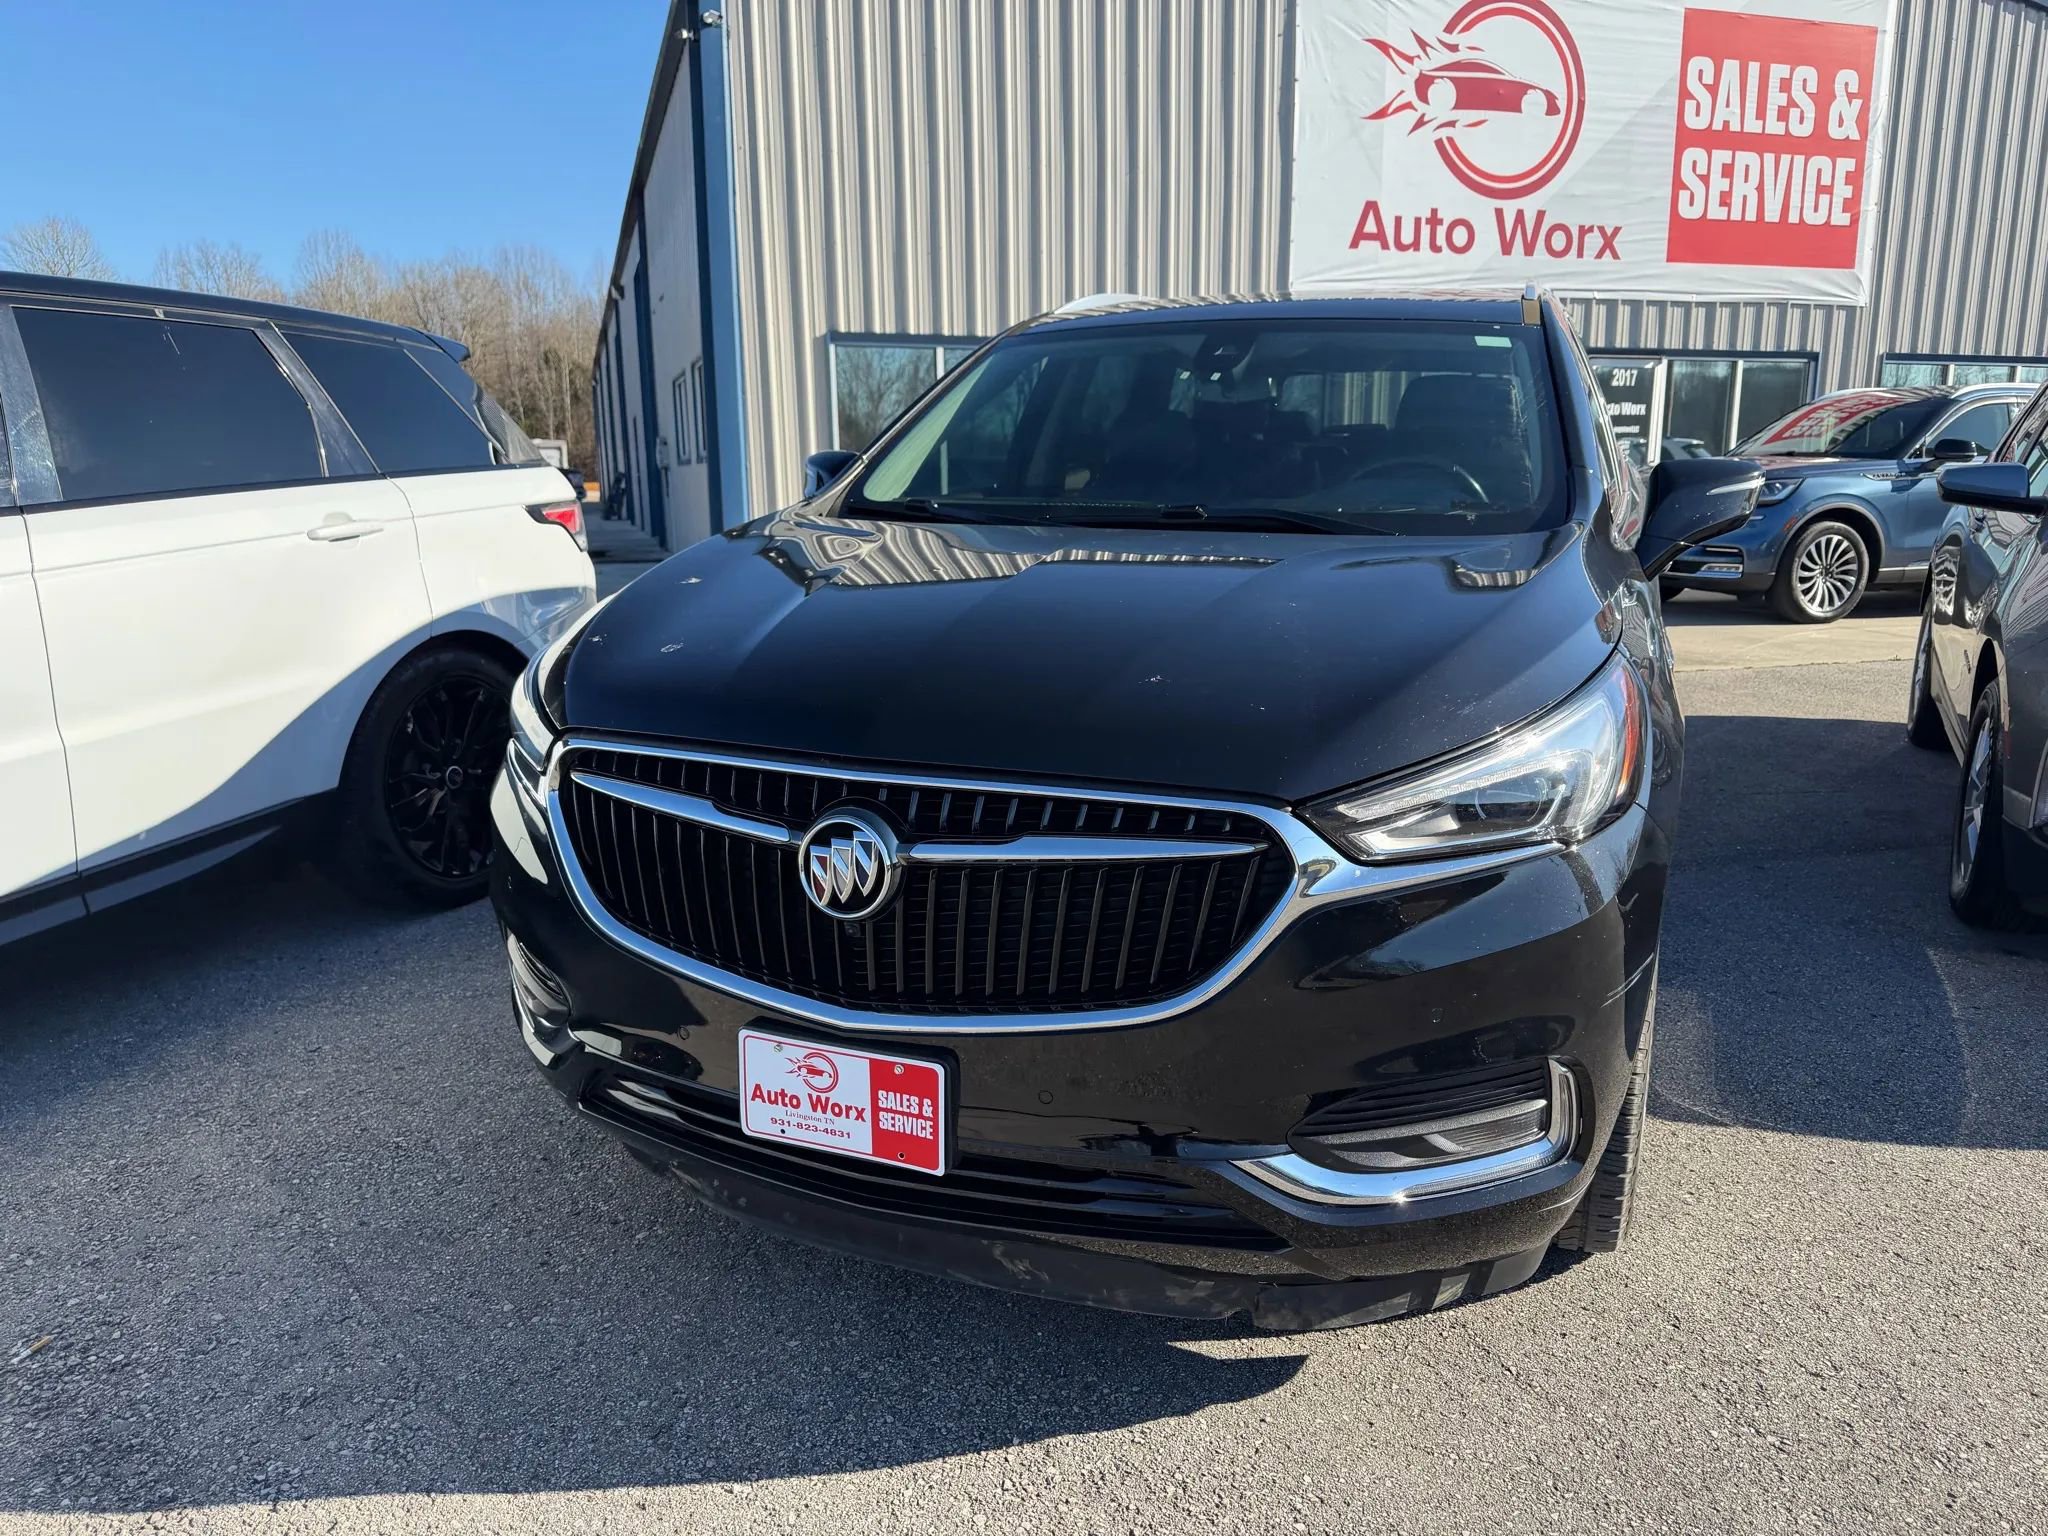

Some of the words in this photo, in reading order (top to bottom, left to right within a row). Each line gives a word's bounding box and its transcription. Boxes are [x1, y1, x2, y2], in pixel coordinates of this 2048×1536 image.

[1684, 55, 1818, 138] SALES
[1828, 68, 1861, 141] &
[1678, 147, 1857, 227] SERVICE
[1348, 200, 1475, 255] Auto
[1494, 207, 1624, 261] Worx
[1611, 368, 1638, 387] 2017
[1621, 401, 1647, 416] Worx
[751, 1083, 802, 1110] Auto
[807, 1092, 867, 1122] Worx
[878, 1090, 919, 1115] SALES
[922, 1098, 933, 1118] &
[770, 1117, 851, 1139] 931-823-4831
[785, 1109, 822, 1124] Livingston
[824, 1116, 835, 1126] TN
[879, 1111, 933, 1140] SERVICE
